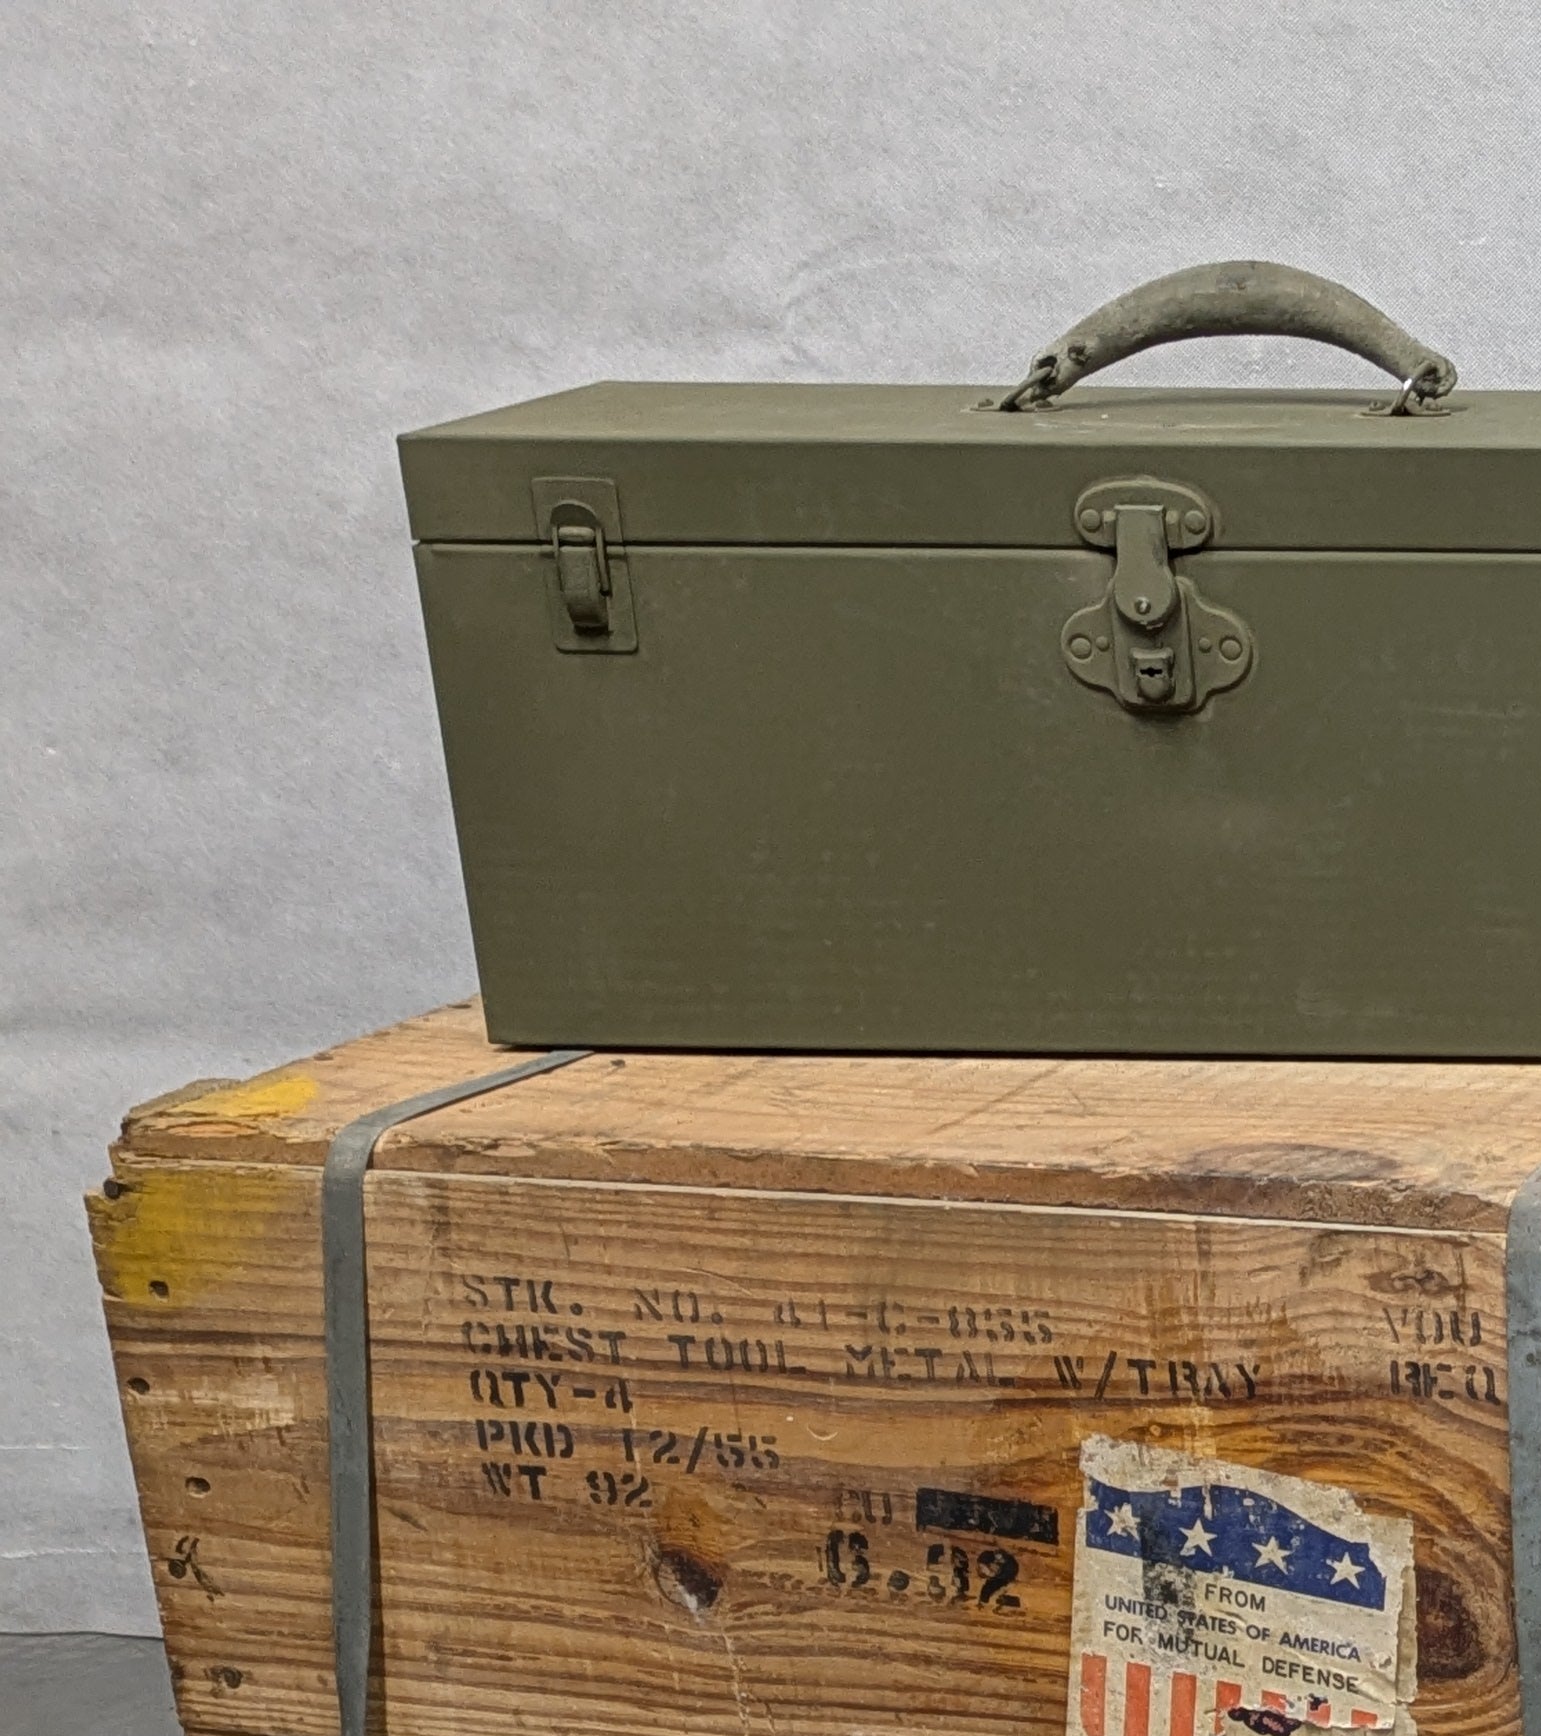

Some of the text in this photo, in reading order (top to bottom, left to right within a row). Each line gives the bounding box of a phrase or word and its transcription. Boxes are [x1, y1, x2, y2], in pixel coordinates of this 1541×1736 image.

[462, 1275, 583, 1315] STK.
[633, 1288, 723, 1323] NO.
[461, 1322, 626, 1364] CHEST
[667, 1335, 806, 1374] TOOL
[845, 1345, 1015, 1386] METAL
[476, 1419, 779, 1474] PKD 12/55
[482, 1462, 652, 1507] WT 92
[1204, 1583, 1266, 1612] FROM
[1104, 1594, 1362, 1662] UNITED STATES OF AMERICA
[1103, 1620, 1360, 1694] FOR MUTUAL DEFENSE
